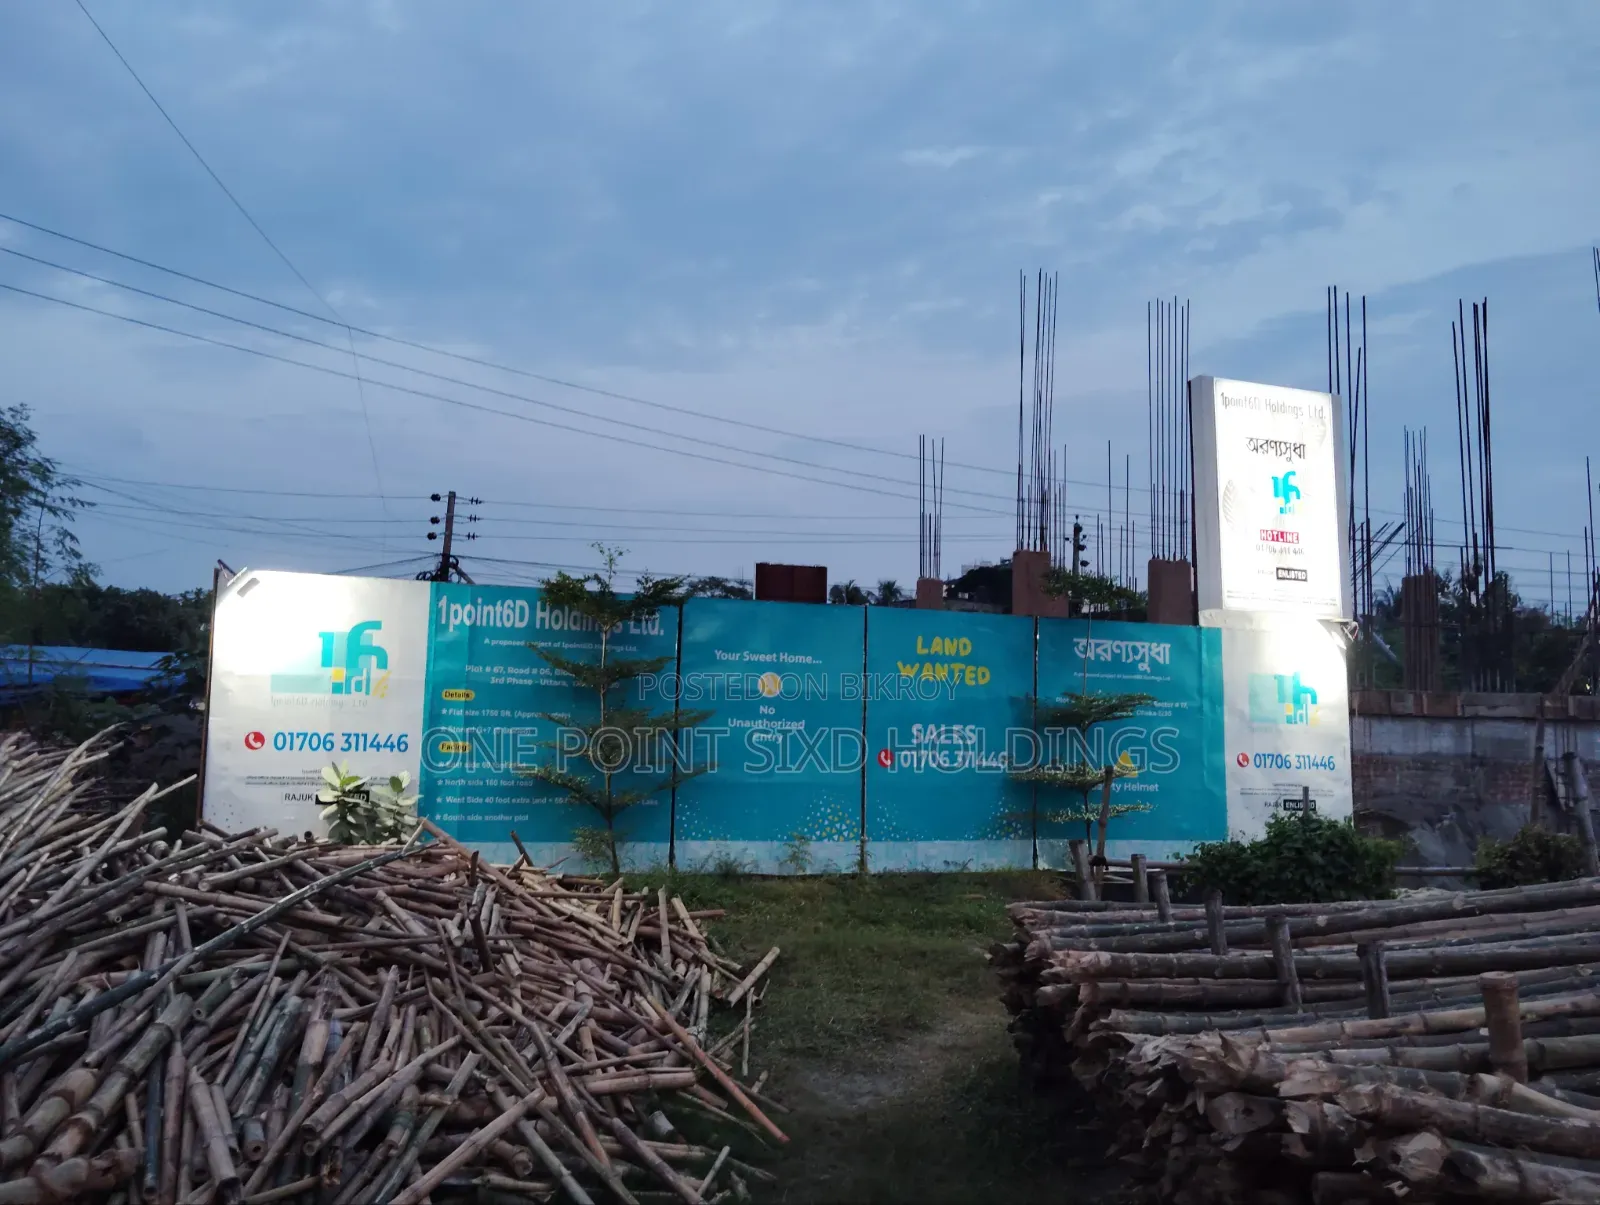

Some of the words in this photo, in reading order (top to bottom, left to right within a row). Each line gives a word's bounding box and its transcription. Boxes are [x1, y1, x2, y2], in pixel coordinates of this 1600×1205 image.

[1261, 530, 1299, 544] HOTLINE
[1278, 569, 1306, 580] ENLISTED
[438, 595, 529, 632] 1point6D
[916, 635, 972, 657] LAND
[715, 650, 741, 663] Your
[742, 651, 777, 663] Sweet
[779, 652, 823, 665] Home...
[465, 665, 484, 673] Plot
[507, 666, 530, 675] Road
[897, 661, 991, 687] WANTED
[490, 676, 505, 684] 3rd
[507, 677, 533, 686] Phase
[759, 705, 776, 716] No
[728, 717, 805, 730] Unauthorized
[753, 732, 784, 745] Entry
[911, 723, 977, 745] SALES
[273, 731, 335, 751] 01706
[340, 732, 408, 753] 311446
[900, 750, 950, 768] 01706
[1253, 752, 1292, 769] 01706
[1295, 754, 1336, 771] 311446
[444, 778, 466, 786] North
[1123, 782, 1159, 792] Helmet
[284, 792, 313, 802] RAJUK
[1285, 801, 1315, 809] ENLISD
[466, 814, 483, 822] side
[484, 814, 513, 822] another
[514, 814, 529, 823] plot
